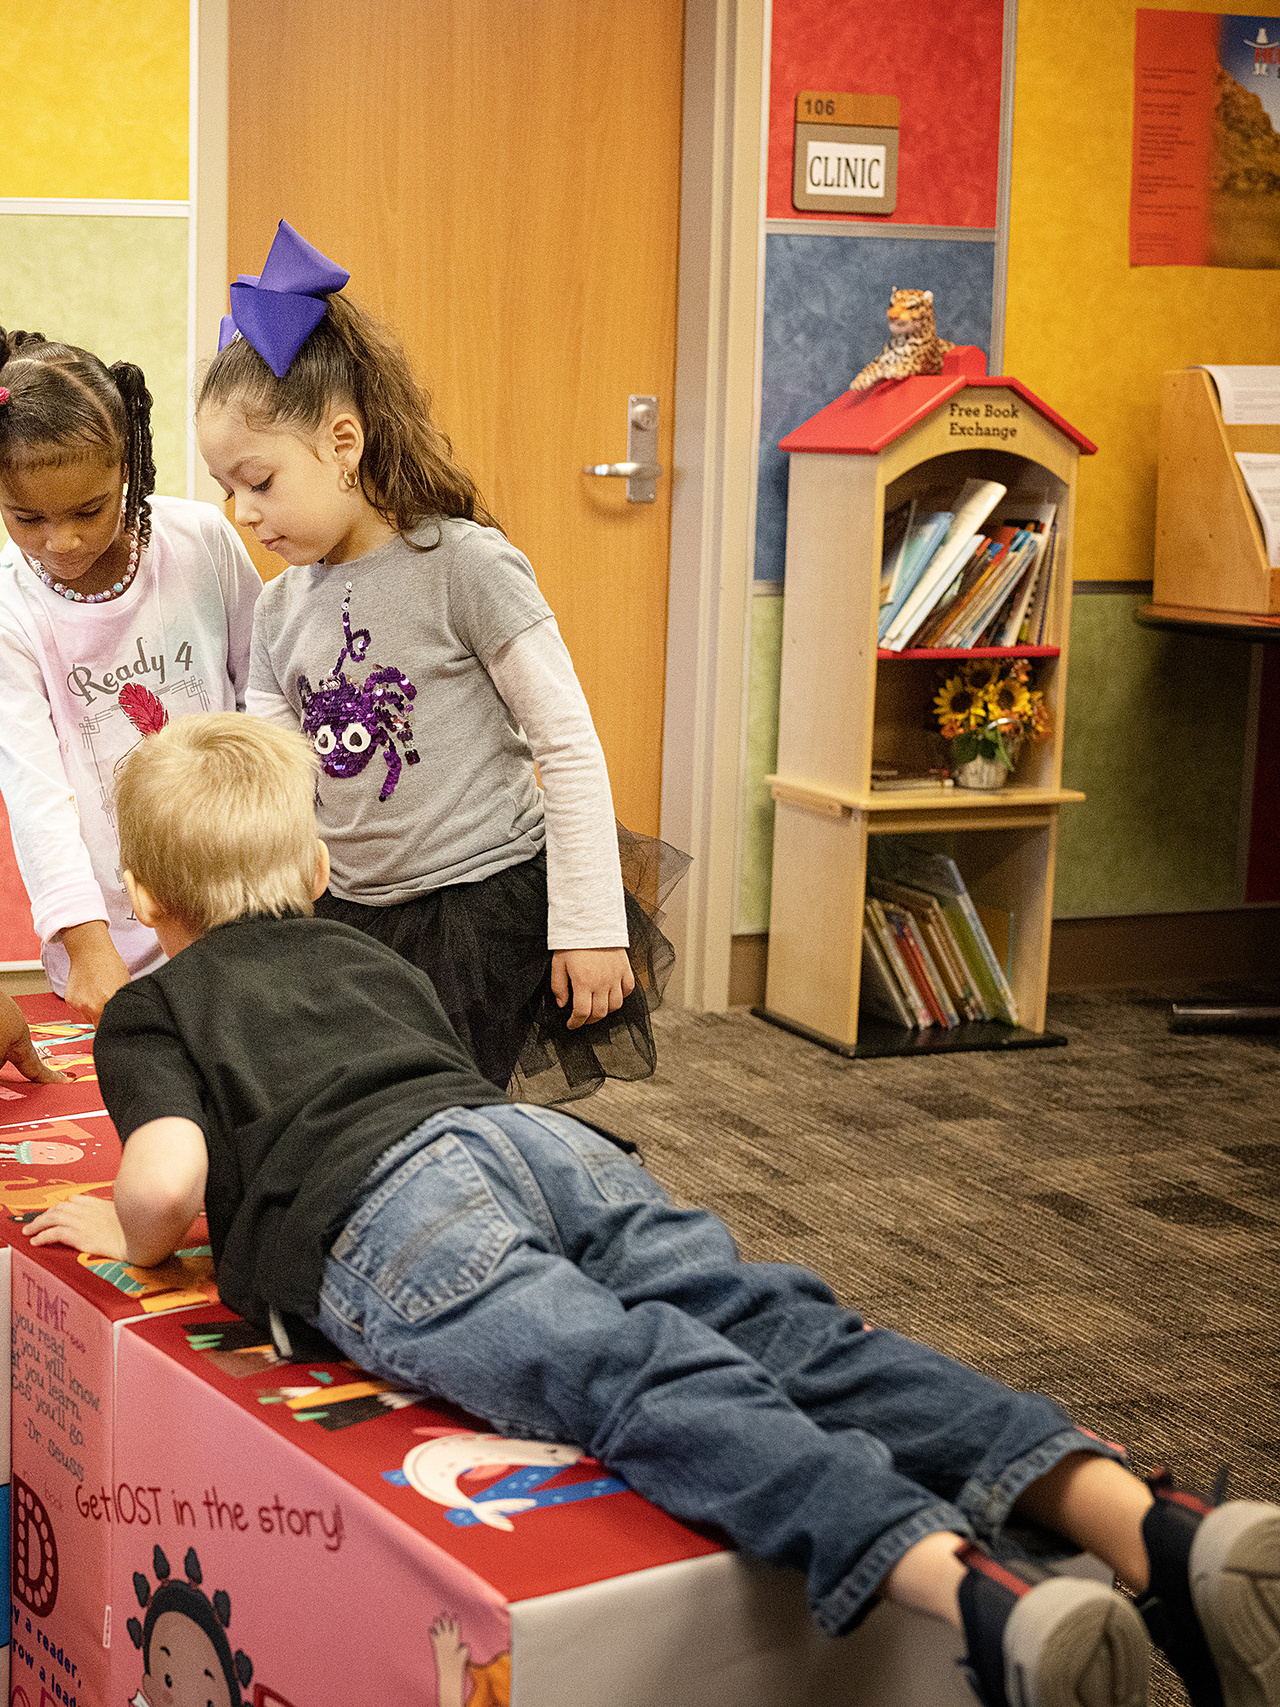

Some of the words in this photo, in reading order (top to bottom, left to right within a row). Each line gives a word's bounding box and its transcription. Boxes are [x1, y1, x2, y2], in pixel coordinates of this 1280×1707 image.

[805, 99, 835, 116] 106
[809, 155, 881, 190] CLINIC
[949, 402, 980, 418] Free
[985, 404, 1019, 419] Book
[949, 421, 1017, 441] Exchange
[67, 637, 166, 706] Ready
[174, 641, 193, 671] 4
[75, 1484, 111, 1522] Get
[171, 1489, 196, 1528] in
[202, 1486, 249, 1531] the
